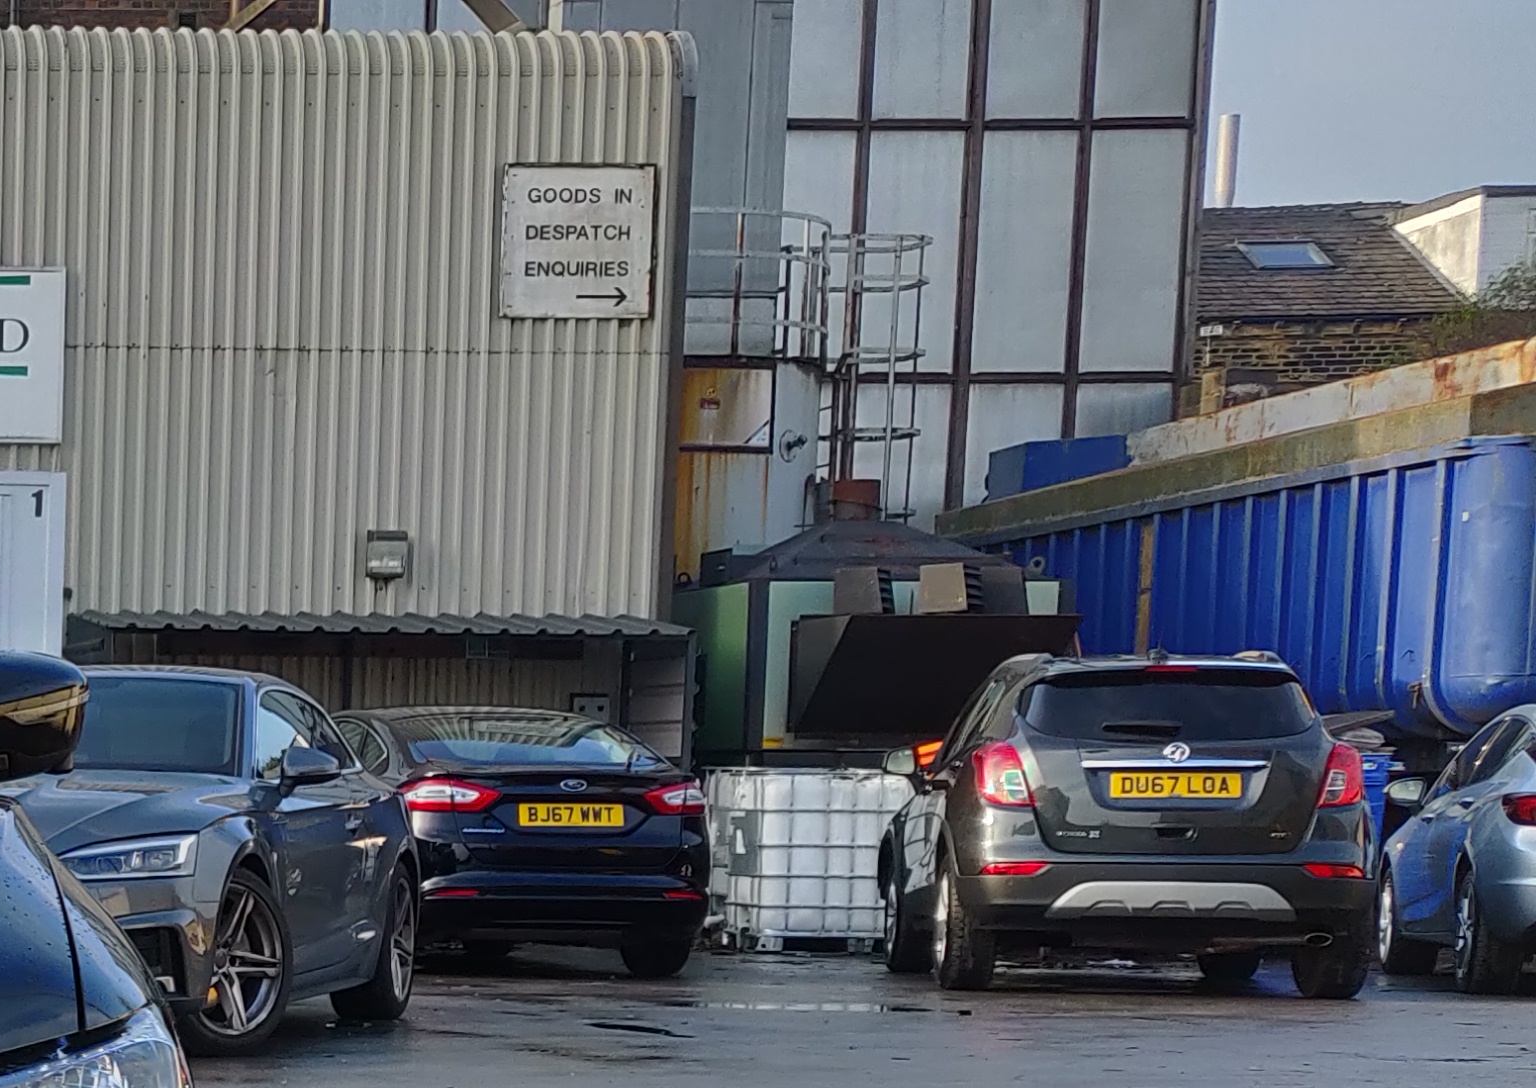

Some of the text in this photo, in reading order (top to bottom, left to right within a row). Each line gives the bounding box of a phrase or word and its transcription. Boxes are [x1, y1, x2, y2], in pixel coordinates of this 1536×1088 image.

[527, 187, 633, 205] GOODS IN
[525, 224, 631, 241] DESPATCH
[524, 261, 629, 277] ENQUIRIES
[31, 490, 43, 517] 1
[1121, 776, 1231, 795] DU67 LOA
[528, 807, 615, 823] BJ67 WWT
